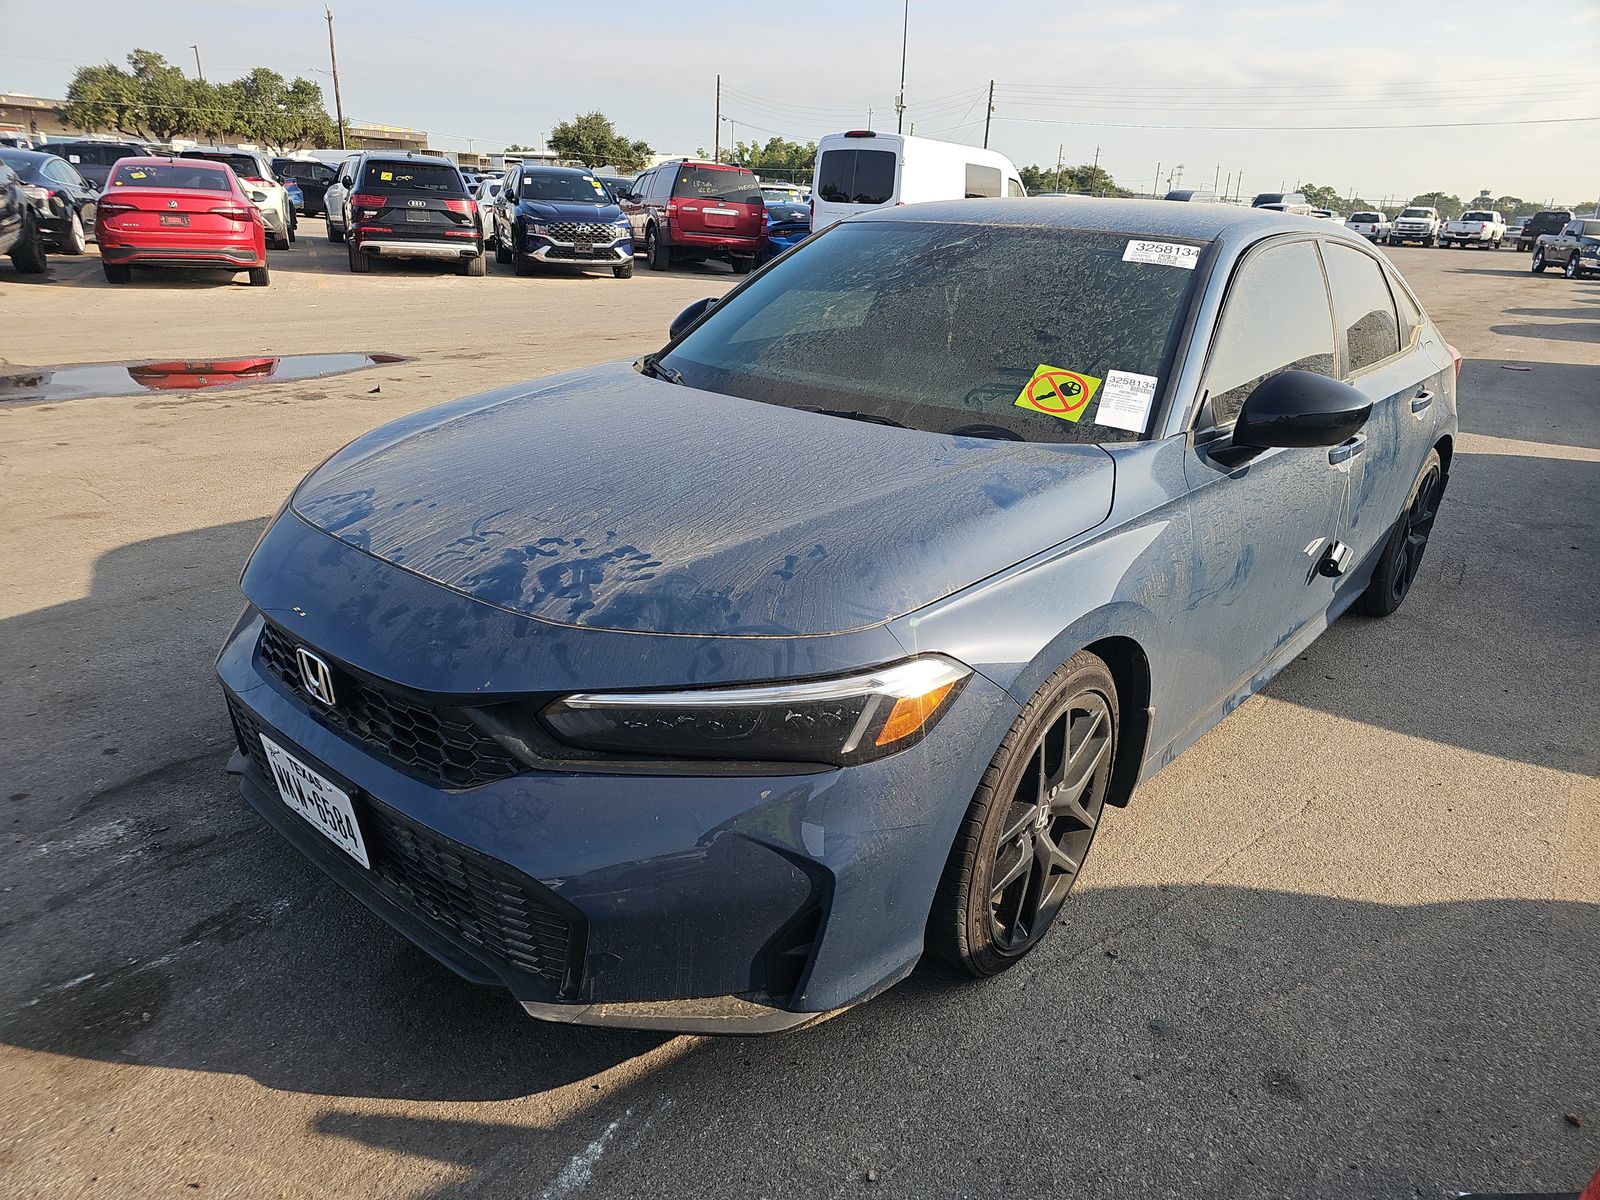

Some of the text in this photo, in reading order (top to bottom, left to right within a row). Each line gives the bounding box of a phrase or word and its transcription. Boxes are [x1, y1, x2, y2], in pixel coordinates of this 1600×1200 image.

[1136, 243, 1200, 257] 3258134
[1109, 376, 1156, 389] 3258134
[286, 756, 324, 792] TEXAS
